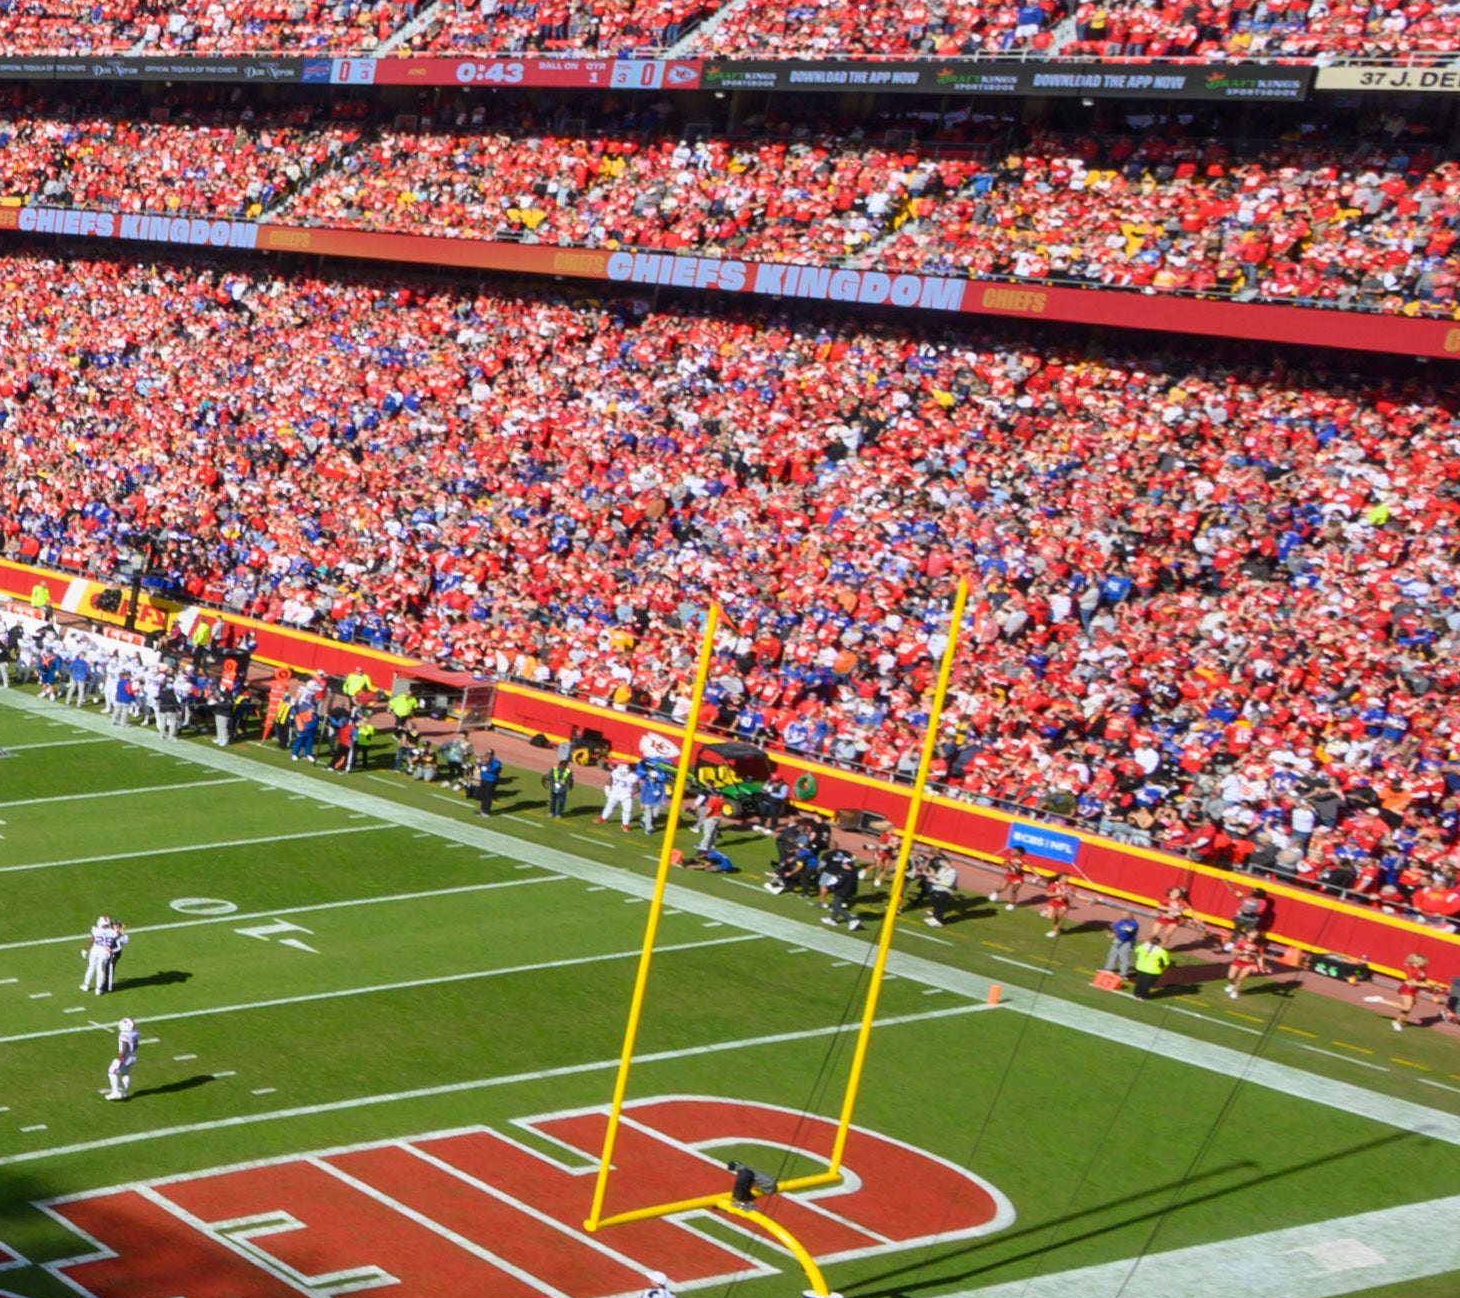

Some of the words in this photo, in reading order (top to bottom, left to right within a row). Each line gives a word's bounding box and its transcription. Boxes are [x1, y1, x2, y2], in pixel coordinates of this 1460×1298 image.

[338, 60, 351, 82] 0
[360, 69, 369, 80] 3
[456, 62, 524, 83] 0:43
[538, 62, 564, 70] BALL
[565, 62, 579, 70] ON
[586, 62, 606, 71] QTR
[588, 74, 598, 84] 1
[617, 73, 627, 84] 3
[640, 63, 655, 86] 0
[789, 70, 847, 83] DOWNLOAD
[848, 71, 867, 83] THE
[868, 71, 890, 84] APP
[891, 71, 918, 84] NOW
[954, 83, 1015, 91] SPORTSBOOK
[1032, 73, 1103, 88] DOWNLOAD
[1104, 74, 1126, 88] THE
[1126, 75, 1151, 89] APP
[1152, 76, 1187, 90] NOW
[1360, 72, 1386, 87] 37
[1390, 72, 1412, 87] J.
[1418, 71, 1460, 87] DE
[1225, 88, 1298, 96] SPORTSBOOK
[19, 207, 114, 237] CHIEFS
[118, 213, 257, 249] KINGDOM
[269, 230, 311, 247] CHIEFS
[553, 251, 604, 275] CHIEFS
[606, 251, 746, 291] CHIEFS
[754, 263, 965, 312] KINGDOM
[982, 287, 1047, 313] CHIEFS
[1023, 833, 1044, 848] CBS
[1049, 840, 1073, 855] NFL
[169, 898, 314, 942] 10
[1100, 975, 1113, 987] G
